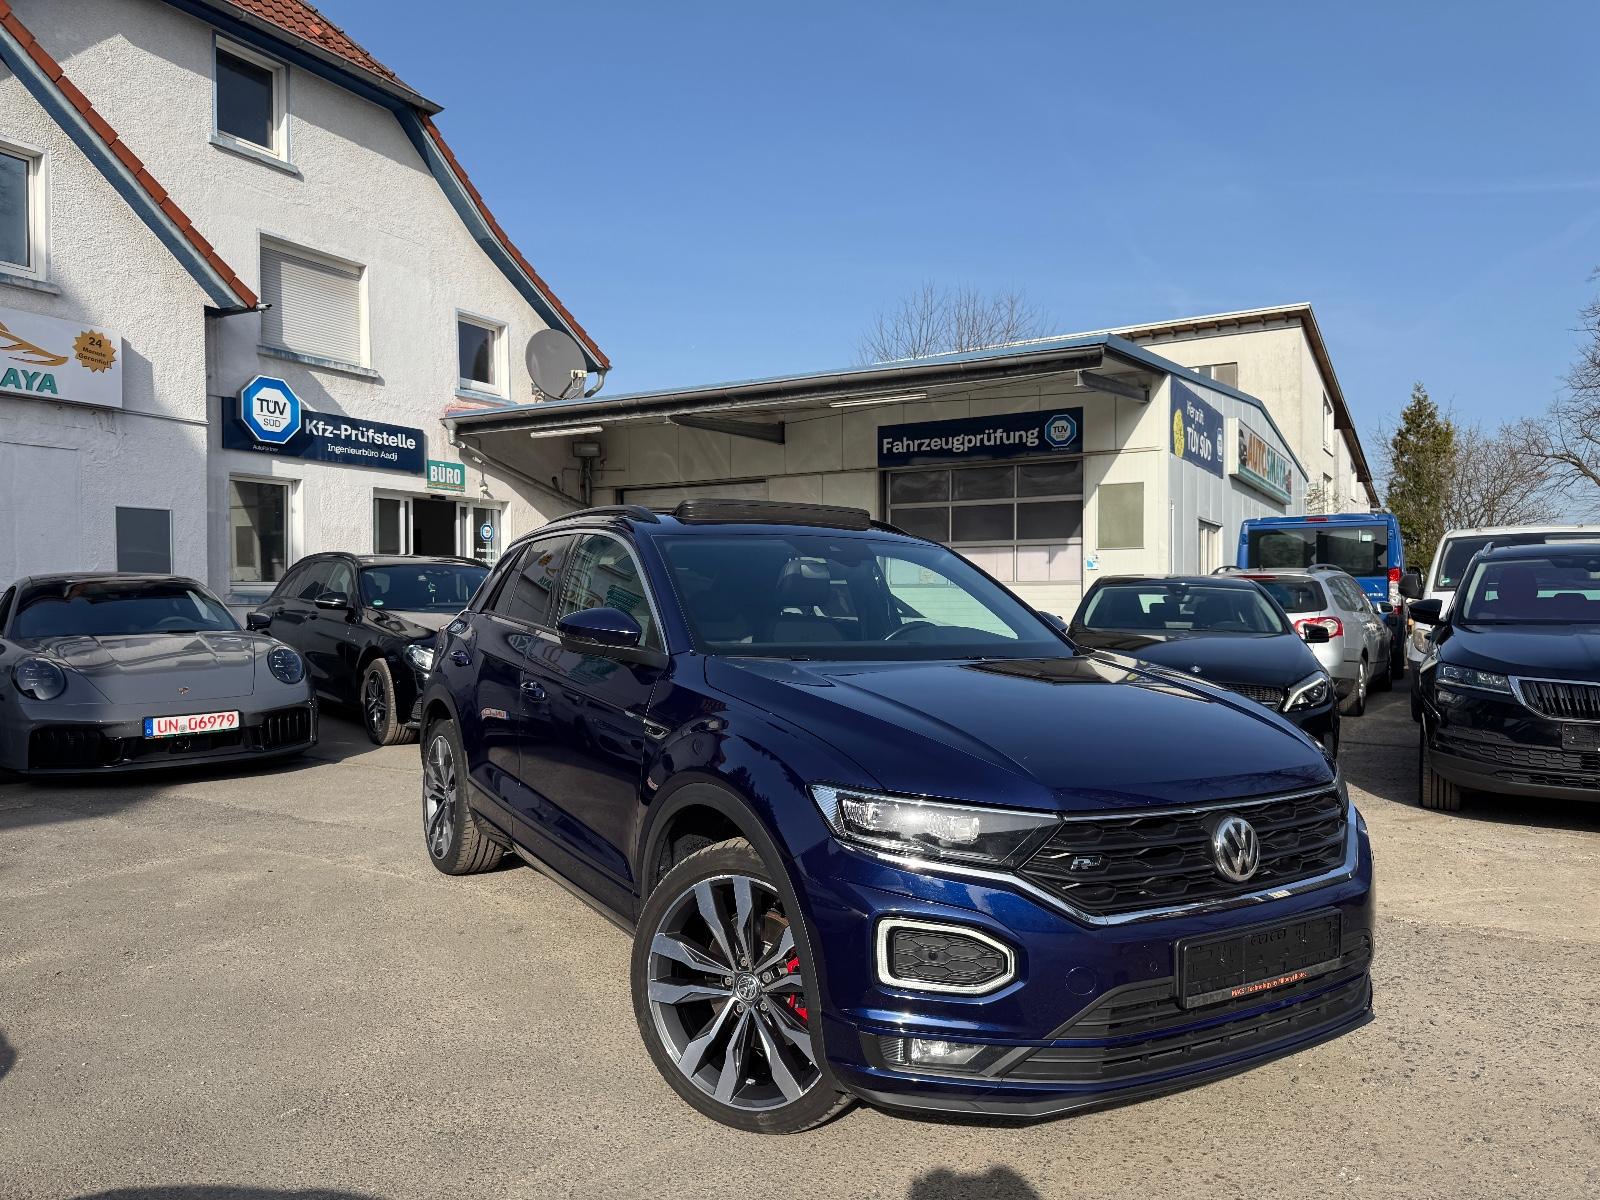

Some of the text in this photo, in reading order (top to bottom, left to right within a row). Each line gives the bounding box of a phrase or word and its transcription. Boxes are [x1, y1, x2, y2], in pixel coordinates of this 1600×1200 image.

[88, 336, 102, 348] 24
[256, 397, 287, 416] TÜV
[263, 417, 281, 428] SÜD
[1053, 424, 1068, 433] TÜV
[305, 418, 416, 449] Kfz-Prüfstelle
[882, 427, 1039, 453] Fahrzeugprüfung
[1187, 424, 1200, 455] TÜV
[1200, 432, 1211, 461] SÜD
[327, 443, 379, 458] Ingenieurbüro
[1247, 433, 1266, 478] AUTO
[430, 464, 461, 484] BÜRO
[158, 719, 179, 733] UN
[188, 714, 235, 730] 06979
